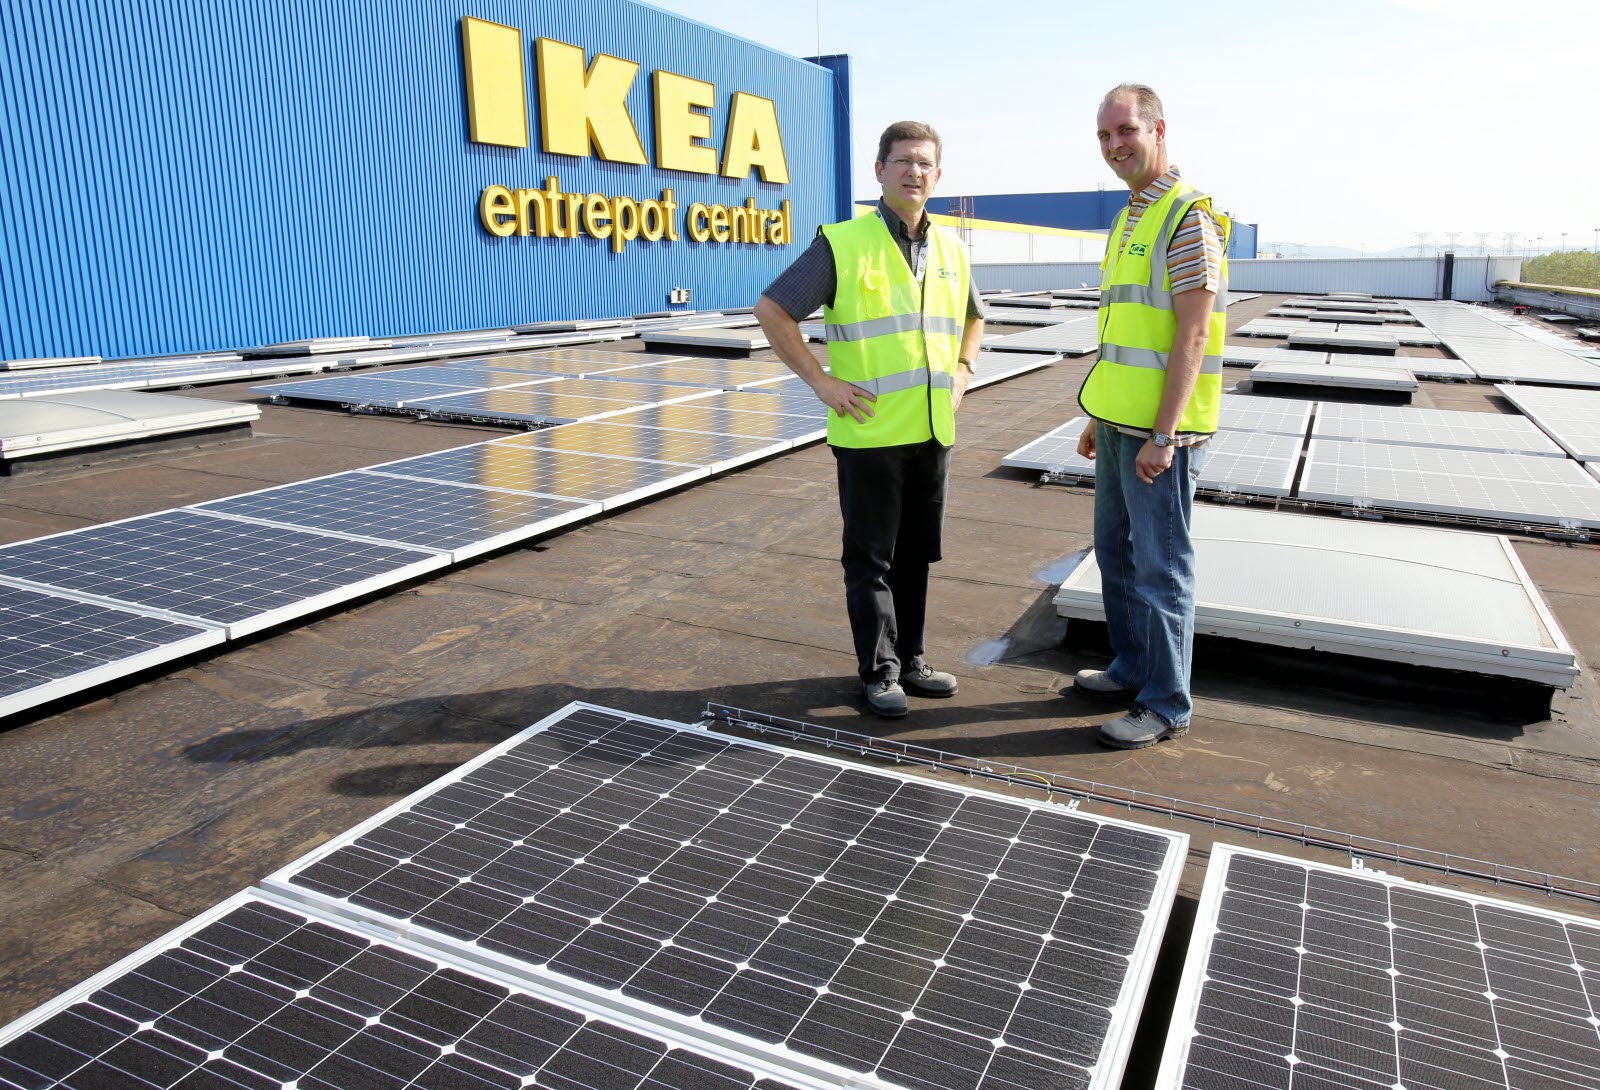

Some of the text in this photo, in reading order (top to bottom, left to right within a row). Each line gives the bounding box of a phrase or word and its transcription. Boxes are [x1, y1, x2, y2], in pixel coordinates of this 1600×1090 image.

[462, 15, 791, 184] IKEA
[480, 176, 792, 253] entrepot central
